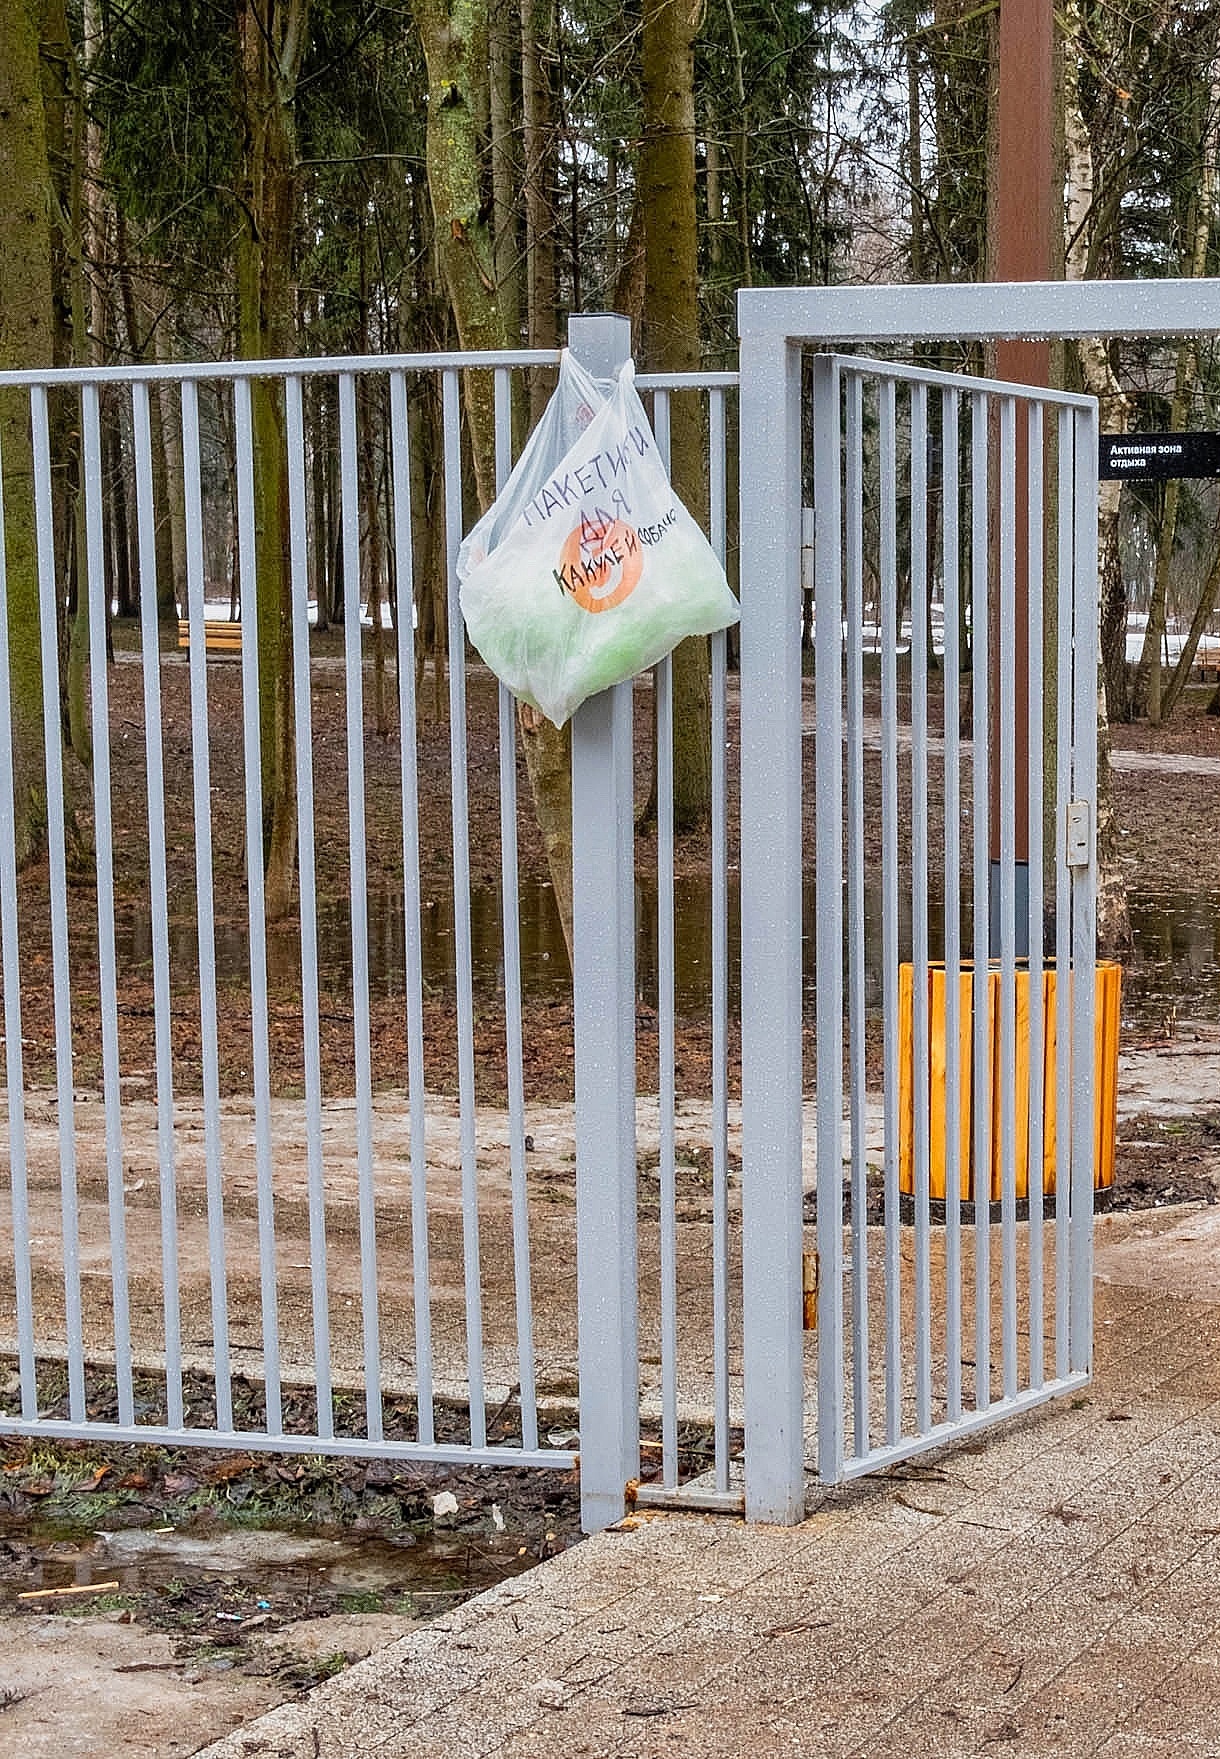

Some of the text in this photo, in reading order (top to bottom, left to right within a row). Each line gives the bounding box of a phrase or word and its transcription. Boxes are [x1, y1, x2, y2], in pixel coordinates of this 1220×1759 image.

[1110, 445, 1182, 455] Активная зона
[1110, 458, 1147, 468] отдыха
[579, 488, 631, 553] ДЛЯ
